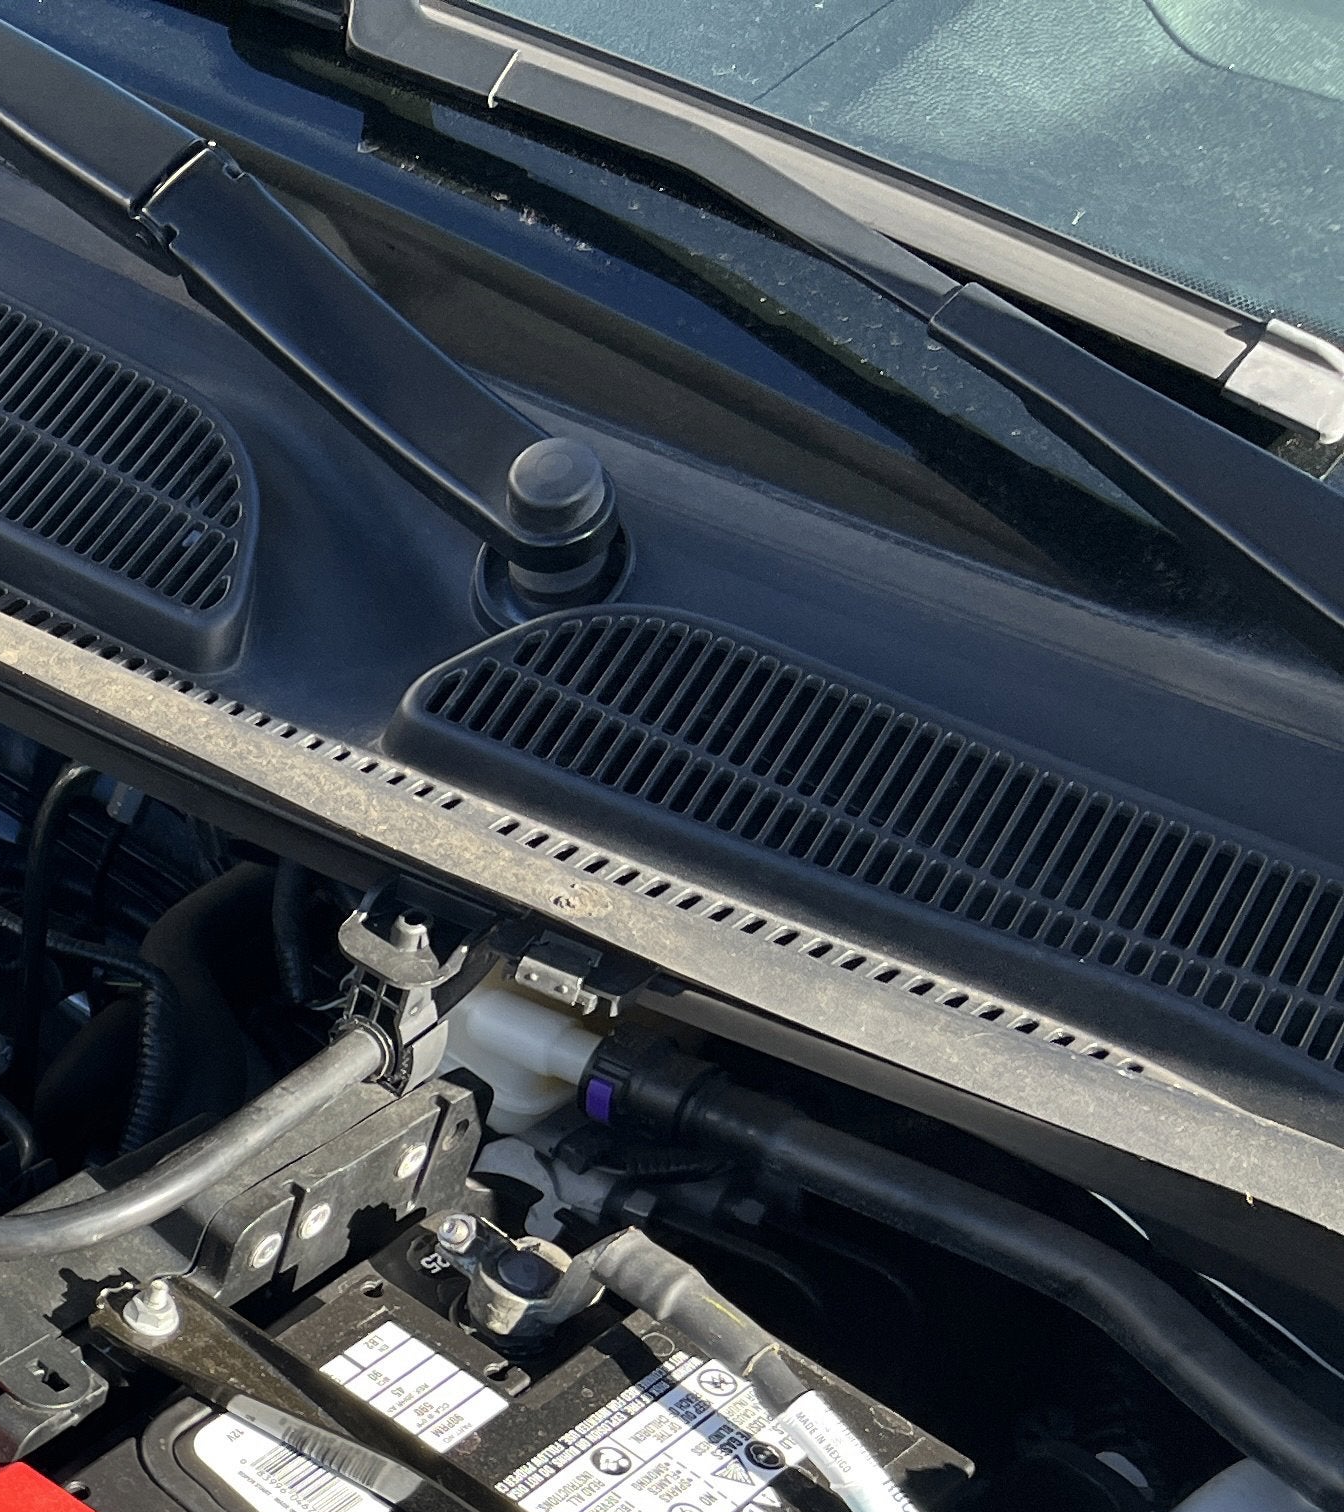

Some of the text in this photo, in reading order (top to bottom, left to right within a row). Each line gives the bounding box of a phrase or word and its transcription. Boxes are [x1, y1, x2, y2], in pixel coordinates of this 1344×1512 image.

[366, 1369, 383, 1381] 90
[389, 1385, 407, 1397] 45
[411, 1401, 434, 1417] 590
[653, 1428, 671, 1444] THE
[794, 1410, 852, 1474] MADE IN MEXICO
[710, 1434, 742, 1461] GASES
[565, 1477, 605, 1508] READ ALL
[698, 1491, 717, 1507] NO
